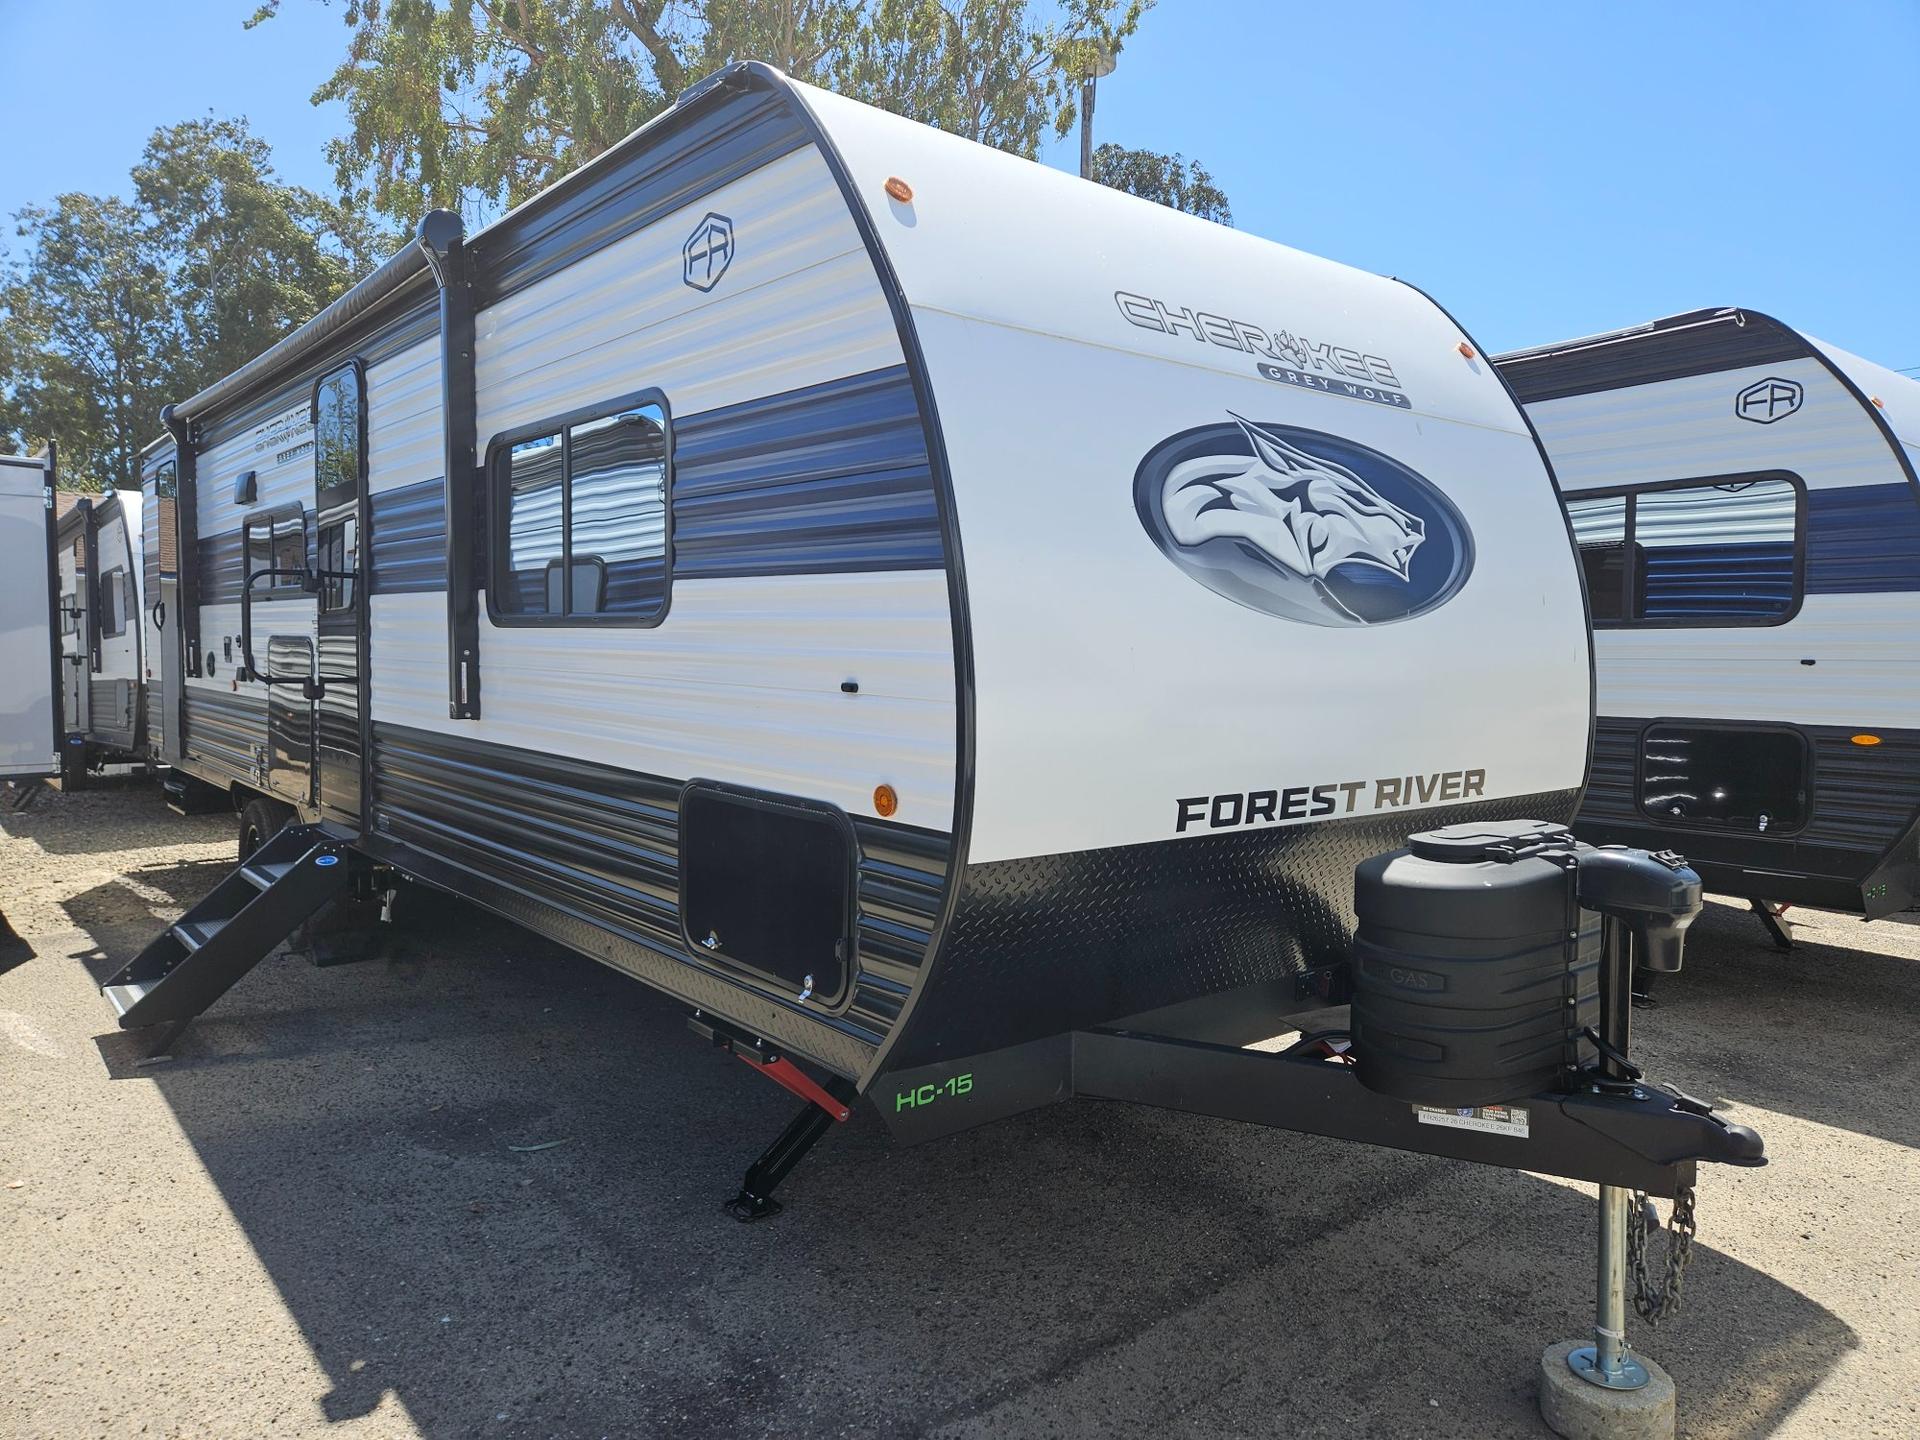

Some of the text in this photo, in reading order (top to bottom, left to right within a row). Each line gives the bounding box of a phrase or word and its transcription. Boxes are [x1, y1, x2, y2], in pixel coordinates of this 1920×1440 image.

[1268, 367, 1402, 404] GREY WOLF
[1176, 768, 1485, 832] FOREST RIVER
[1390, 968, 1428, 988] GAS
[896, 1073, 973, 1112] HC-15
